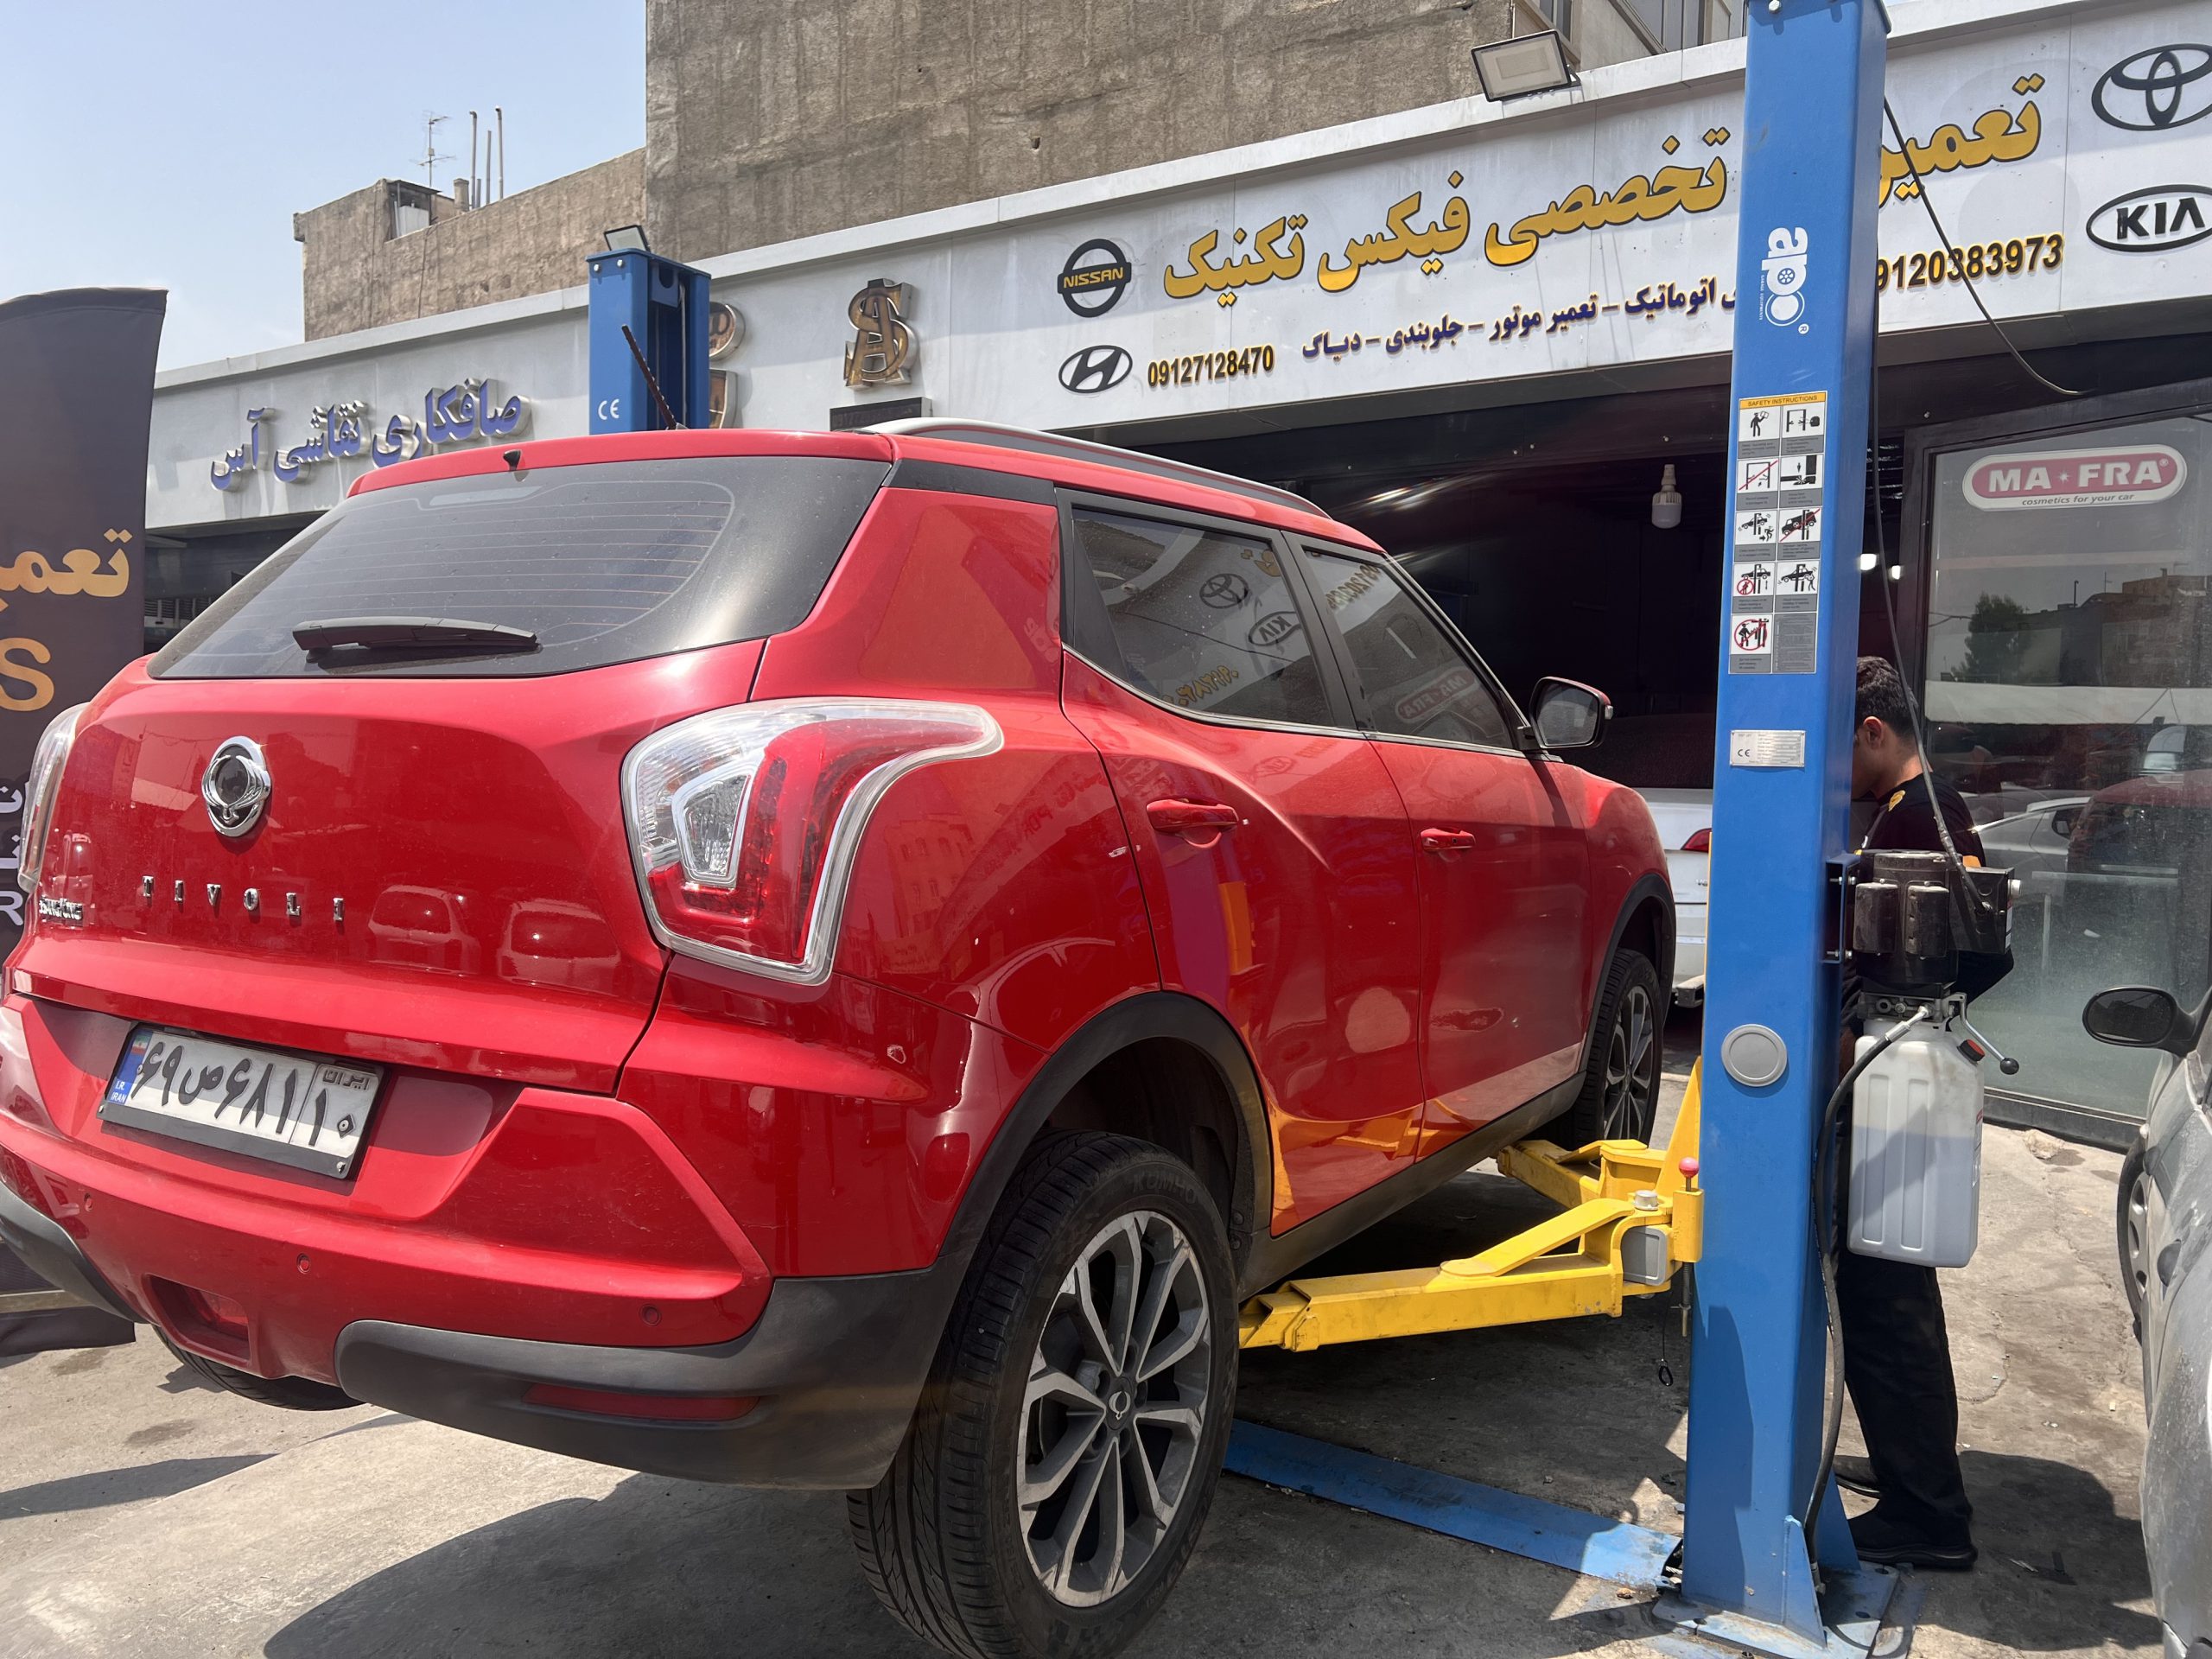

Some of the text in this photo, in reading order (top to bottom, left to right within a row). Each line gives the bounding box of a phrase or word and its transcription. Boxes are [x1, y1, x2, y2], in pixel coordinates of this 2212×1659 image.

[1484, 127, 1731, 266] تخصصی
[1317, 170, 1471, 293] فیکس
[2116, 198, 2206, 240] KIA
[1063, 266, 1124, 289] NISSAN
[1164, 213, 1309, 308] تکنیک
[1878, 232, 2064, 291] 9120383973
[1546, 293, 1599, 334] تعمیر
[1624, 276, 1716, 320] اتوماتیک
[1385, 314, 1465, 354] جلوبندی
[1489, 305, 1541, 342] موتور
[1147, 344, 1275, 388] 09127128470
[597, 398, 620, 421] CE
[1771, 395, 1818, 405] INSTRUCTIONS
[273, 399, 370, 483] نقاشی
[372, 377, 531, 468] صافکاری
[1988, 460, 2162, 493] MA FRA
[2022, 496, 2070, 505] cosmetics
[2074, 495, 2088, 504] for
[2089, 494, 2117, 505] your
[1737, 748, 1751, 757] CE
[143, 875, 345, 922] TIVOLI
